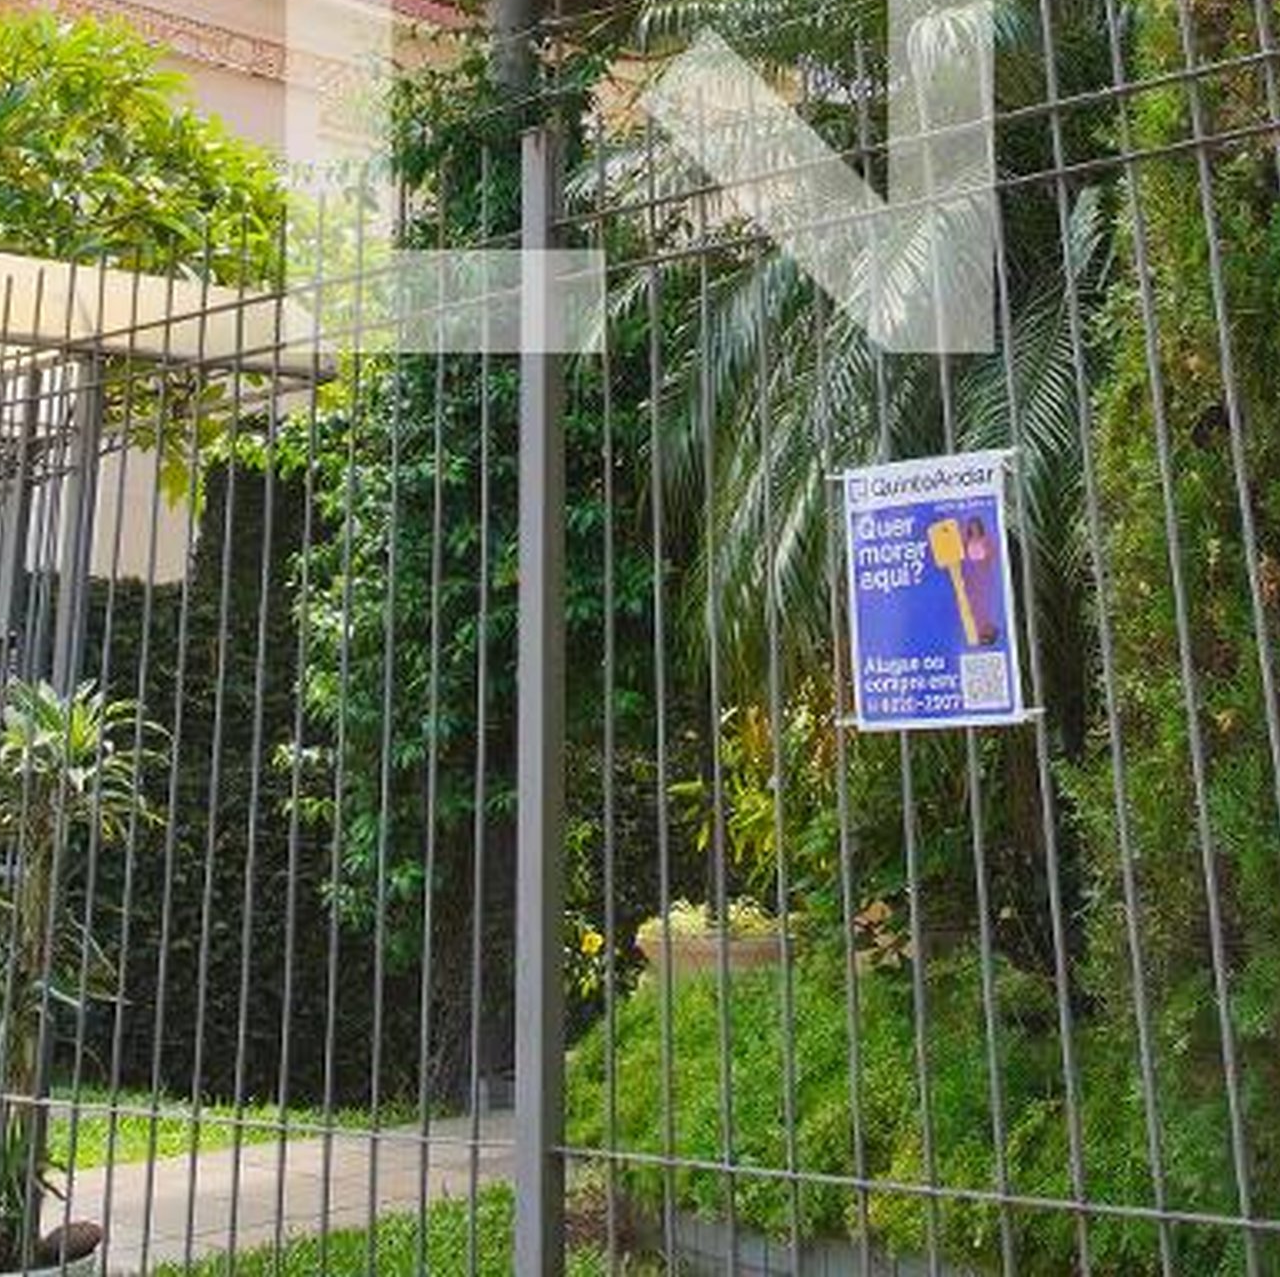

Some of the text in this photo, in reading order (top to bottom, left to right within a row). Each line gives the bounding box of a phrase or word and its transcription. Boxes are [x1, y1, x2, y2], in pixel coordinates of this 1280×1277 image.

[871, 468, 994, 498] QuintoAndar
[859, 516, 915, 540] Quer
[859, 541, 928, 566] morar
[860, 562, 925, 592] aqui?
